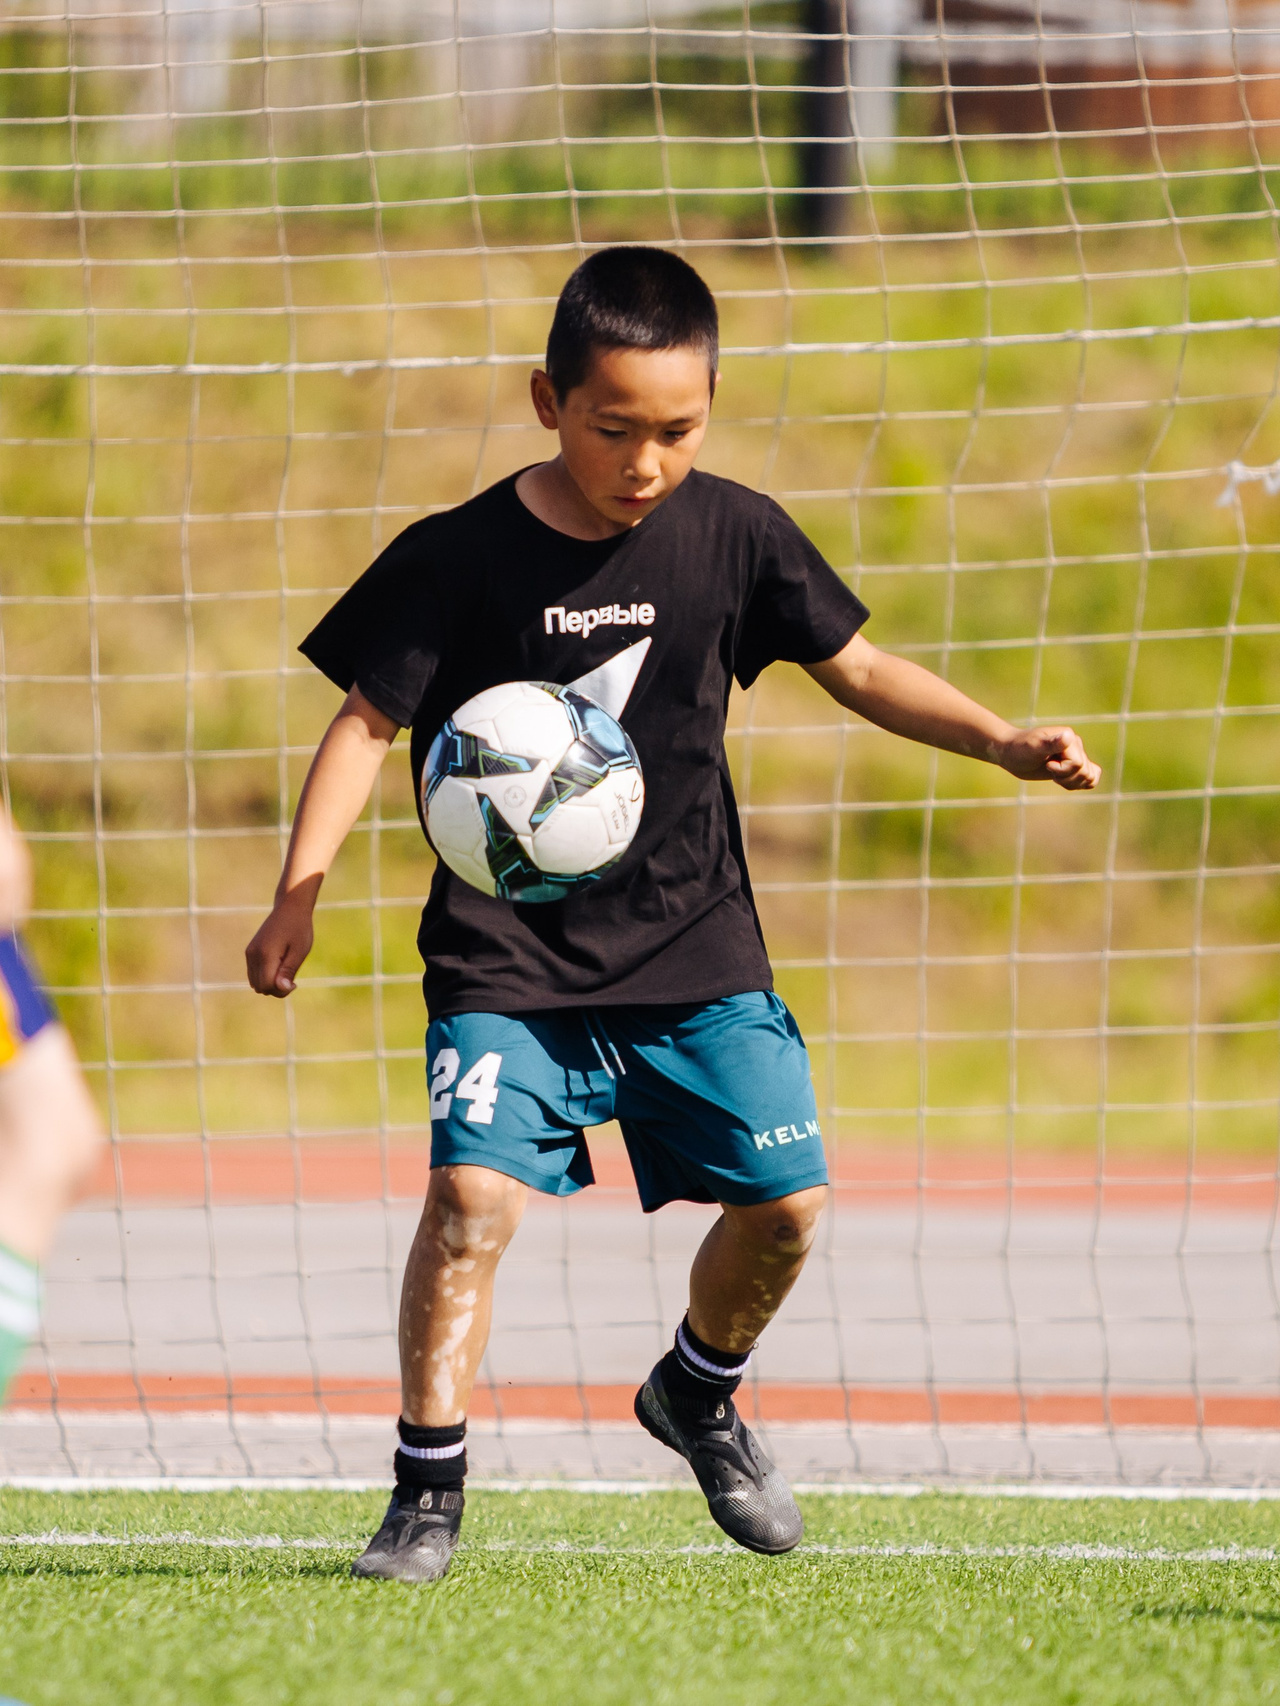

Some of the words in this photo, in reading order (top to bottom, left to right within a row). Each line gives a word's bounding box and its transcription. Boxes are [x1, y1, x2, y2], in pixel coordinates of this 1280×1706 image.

[544, 602, 656, 639] Первые
[429, 1047, 504, 1126] 24
[753, 1119, 822, 1151] KELM
